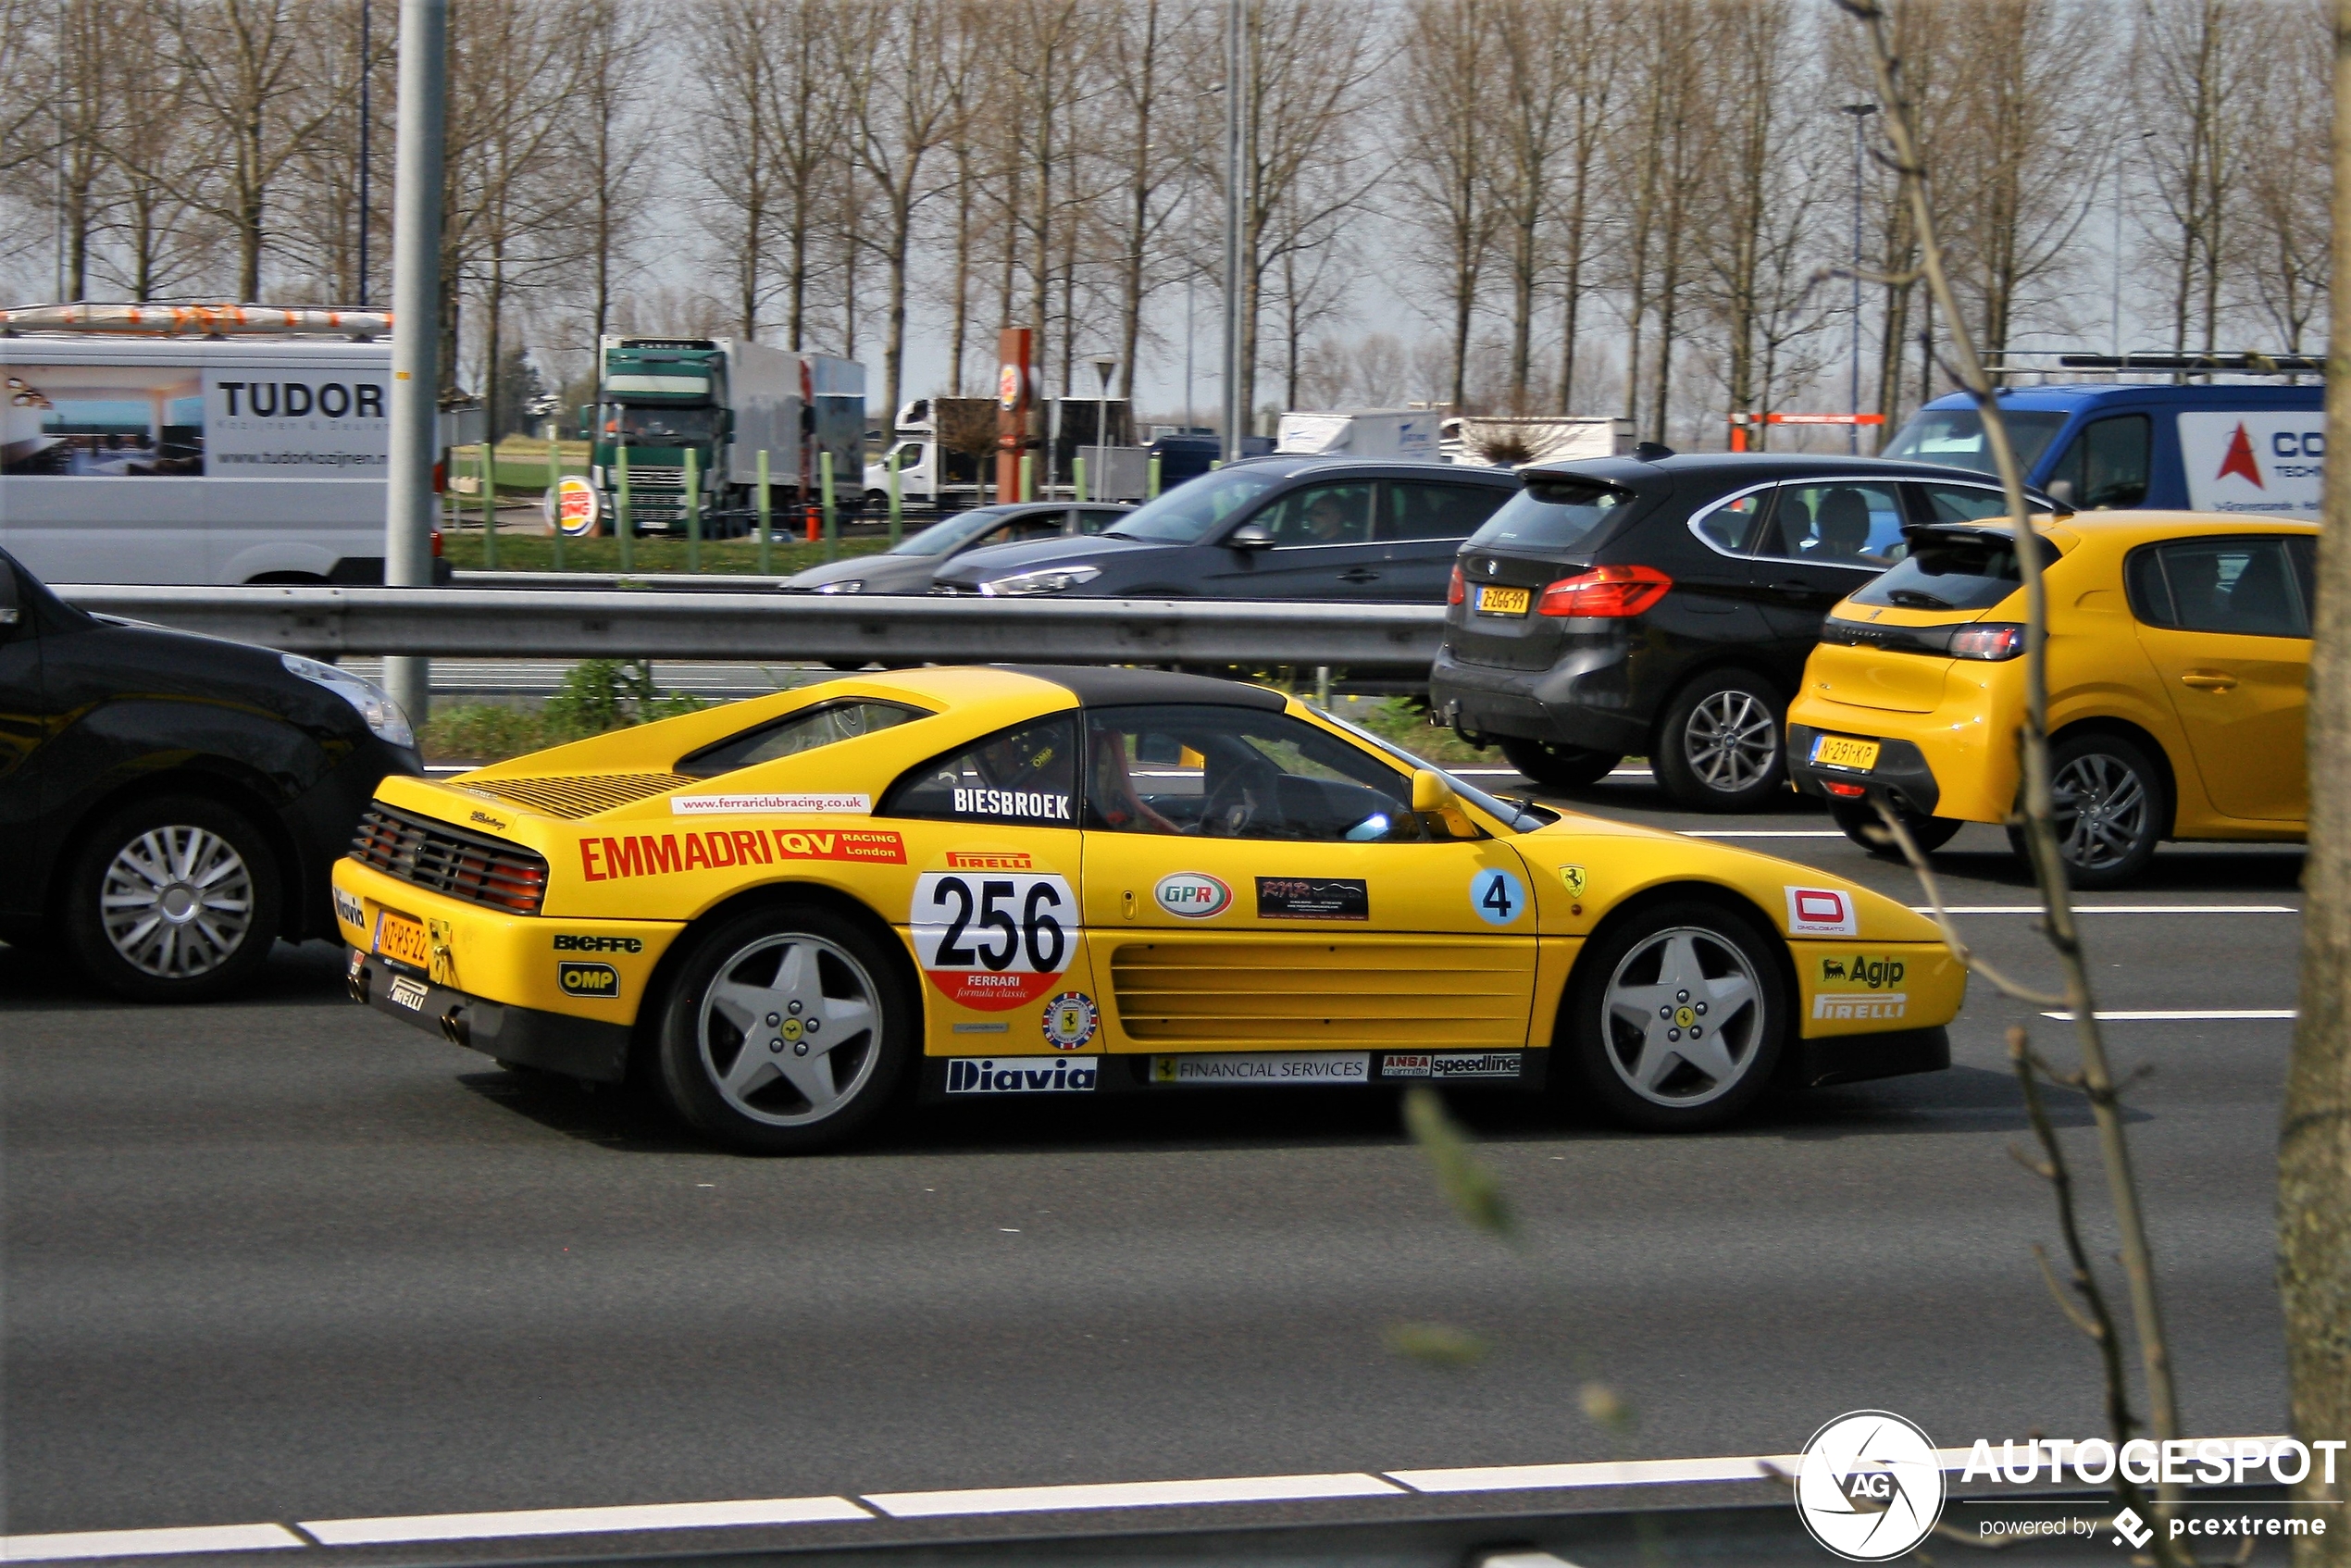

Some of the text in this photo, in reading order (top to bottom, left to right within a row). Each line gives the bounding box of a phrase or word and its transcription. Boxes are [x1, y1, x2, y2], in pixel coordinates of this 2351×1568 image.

[218, 382, 383, 417] TUDOR
[1483, 591, 1524, 610] 2-ZGG-99
[1032, 747, 1053, 768] OMP
[1820, 741, 1872, 764] N-291-KP
[683, 797, 862, 811] www.ferrariclubracing.co.uk
[953, 788, 1070, 820] BIESBROEK
[780, 833, 836, 854] QV
[842, 833, 898, 844] RACING
[578, 830, 774, 881] EMMADRI
[846, 845, 897, 857] London
[946, 852, 1032, 868] PIRELLI
[1164, 886, 1212, 903] GPR
[1482, 875, 1511, 916] 4
[933, 876, 1064, 974] 256
[381, 917, 427, 962] NZ-RS-22
[565, 970, 614, 989] OMP
[967, 976, 1020, 987] FERRARI
[1848, 956, 1905, 989] Agip
[956, 988, 1028, 998] formula classic
[1812, 993, 1907, 1018] PIRELLI
[1180, 1061, 1363, 1077] FINANCIAL SERVICES
[1384, 1056, 1428, 1067] ANSA
[1434, 1055, 1520, 1075] speedline
[949, 1058, 1097, 1091] Diavia
